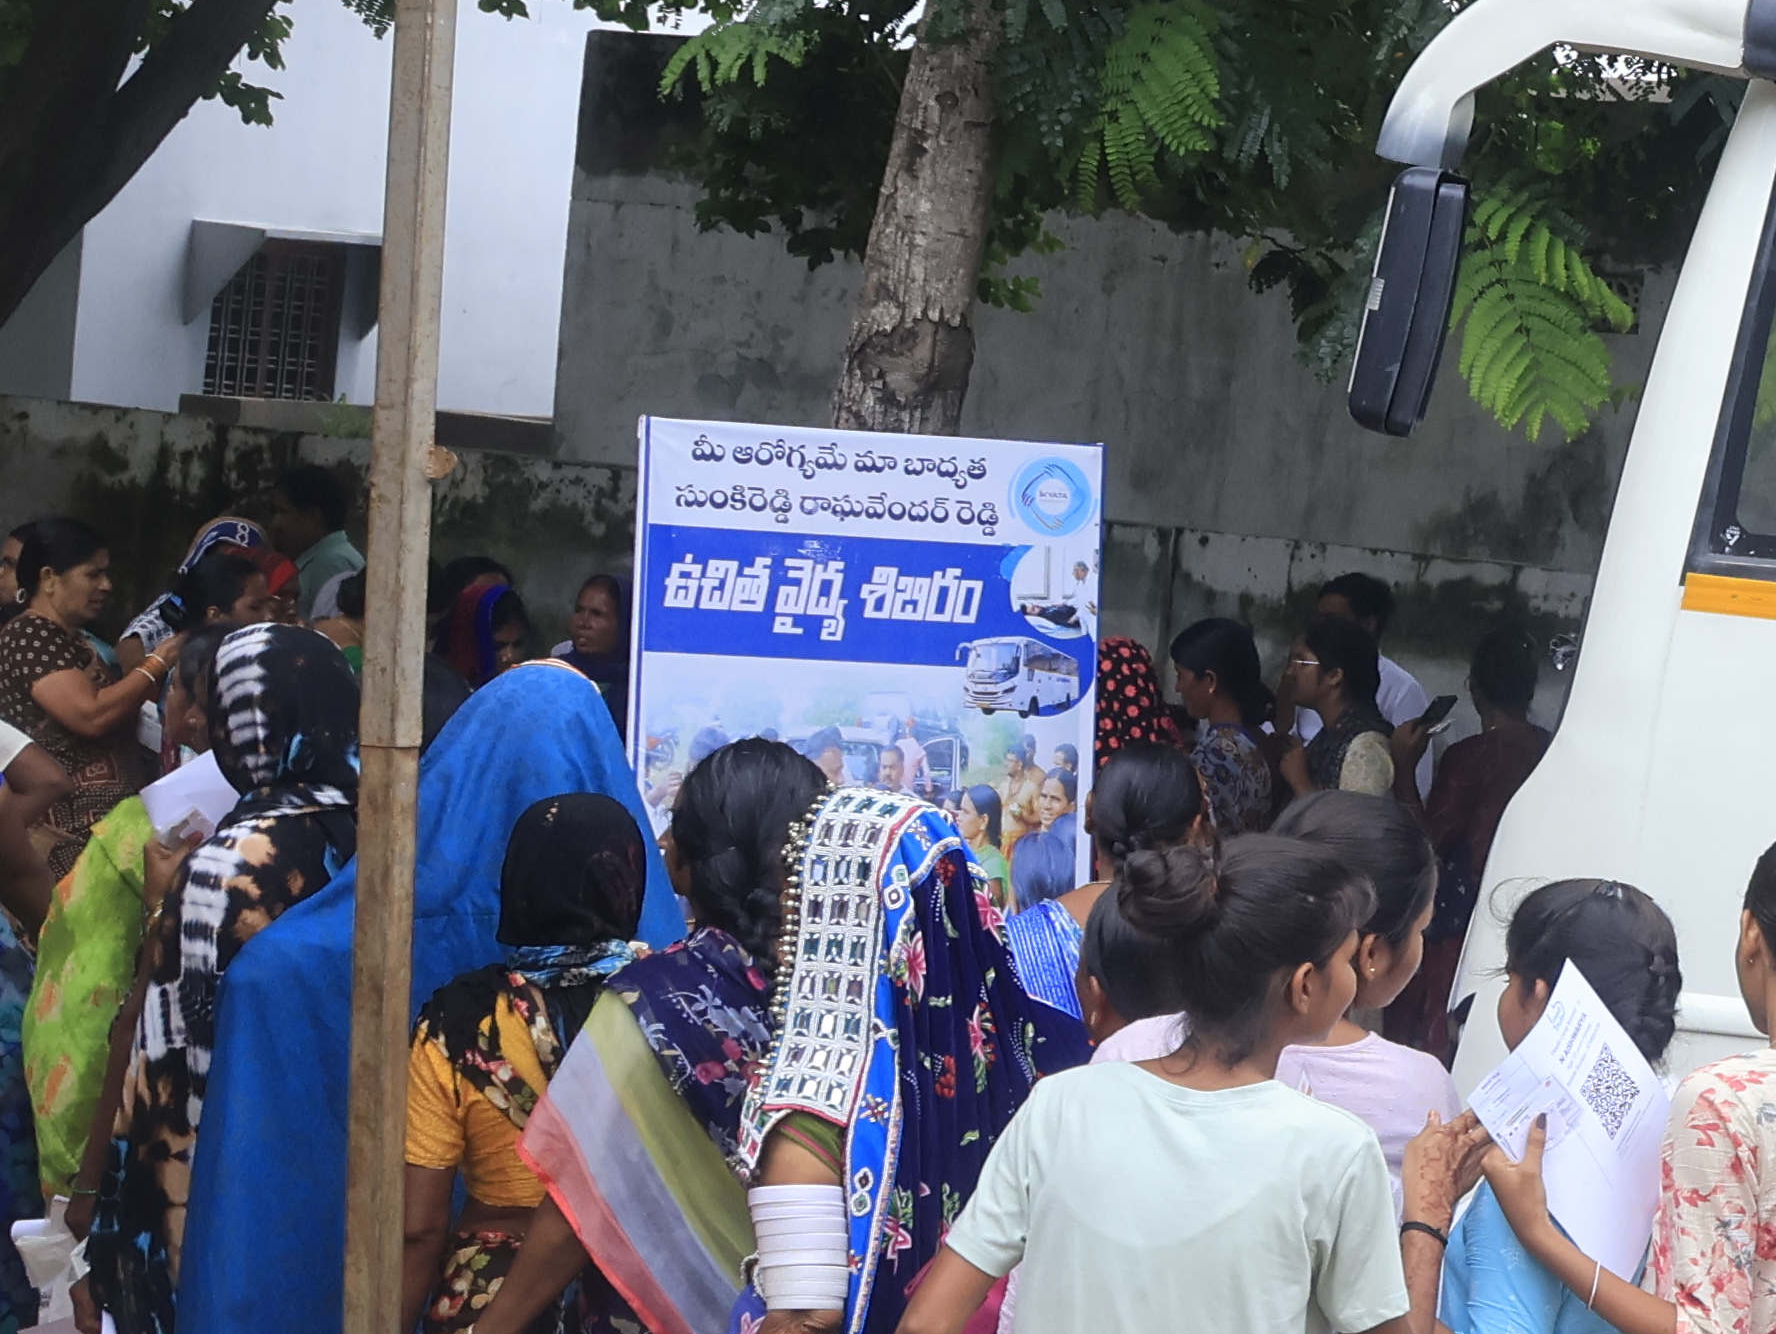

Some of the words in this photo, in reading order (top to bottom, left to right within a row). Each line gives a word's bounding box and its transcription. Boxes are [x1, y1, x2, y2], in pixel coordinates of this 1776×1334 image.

[691, 434, 726, 462] మీ
[732, 439, 847, 479] ఆరోగ్యమే
[854, 450, 898, 473] మా
[904, 456, 987, 489] బాద్యత
[675, 484, 792, 524] సుంకిరెడ్డి
[955, 500, 999, 536] రెడ్డి
[663, 554, 772, 612] ఉచిత
[772, 558, 848, 641] వైద్య
[860, 566, 983, 624] శిబిరం
